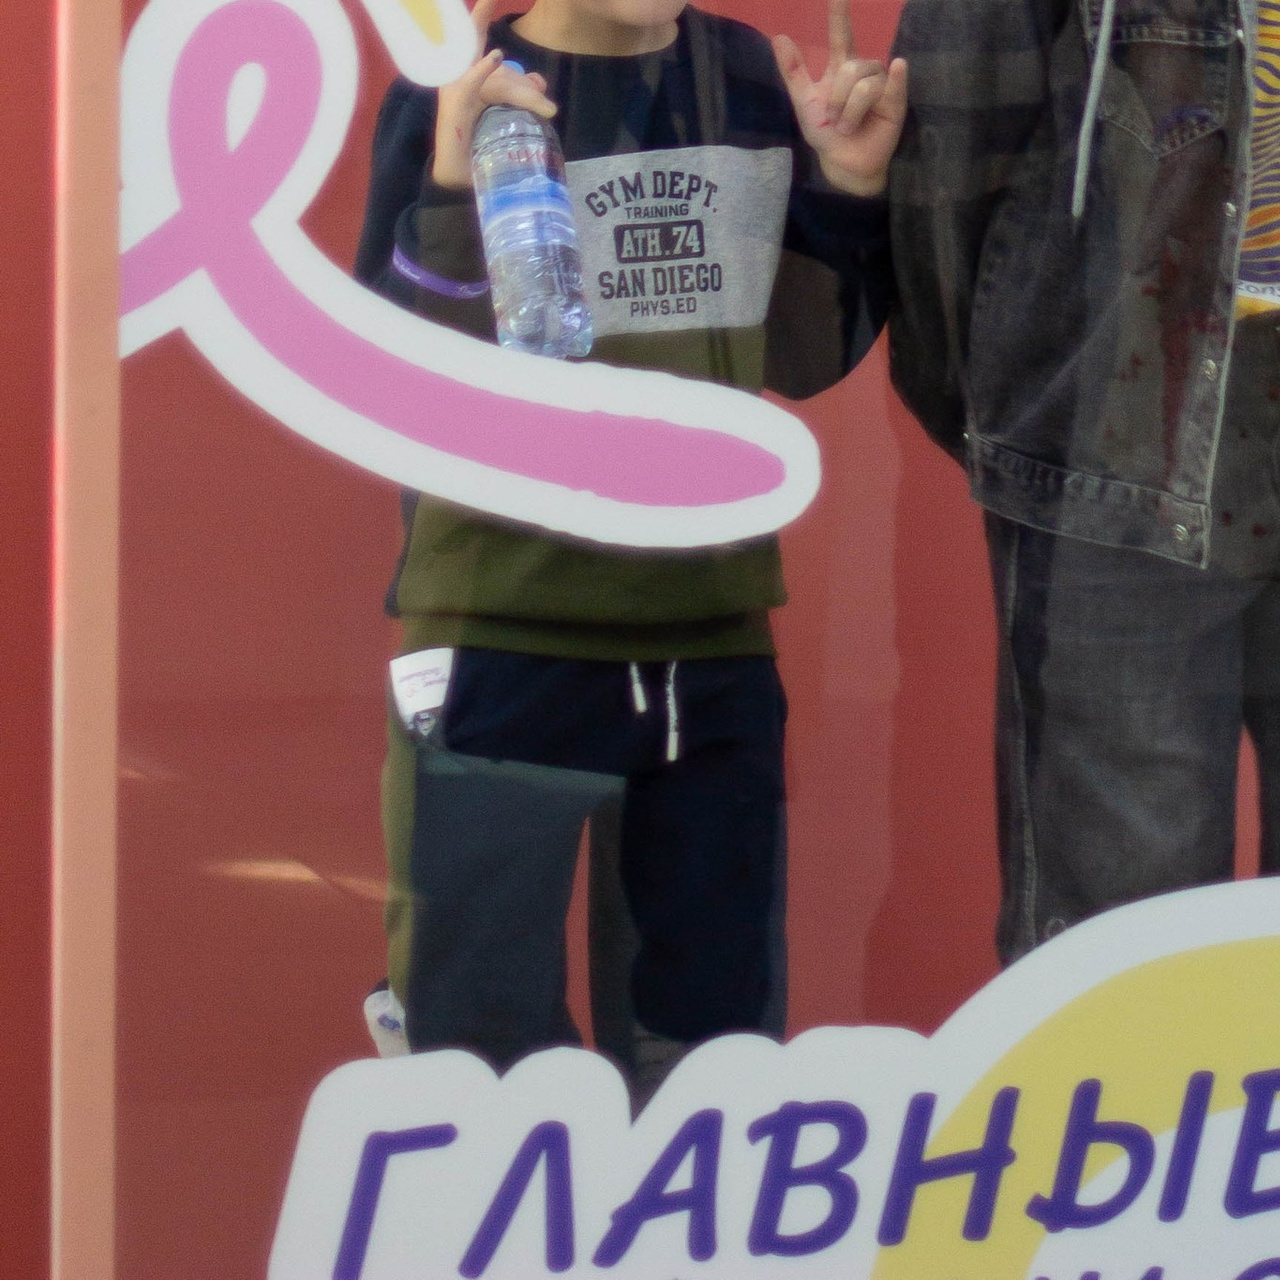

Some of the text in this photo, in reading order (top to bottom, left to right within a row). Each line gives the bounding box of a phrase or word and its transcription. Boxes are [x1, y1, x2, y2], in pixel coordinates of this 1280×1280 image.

[584, 170, 719, 217] GYM DEPT.
[624, 203, 690, 220] TRAINING
[598, 262, 722, 300] SAN DIEGO
[629, 296, 697, 318] PHYS.ED
